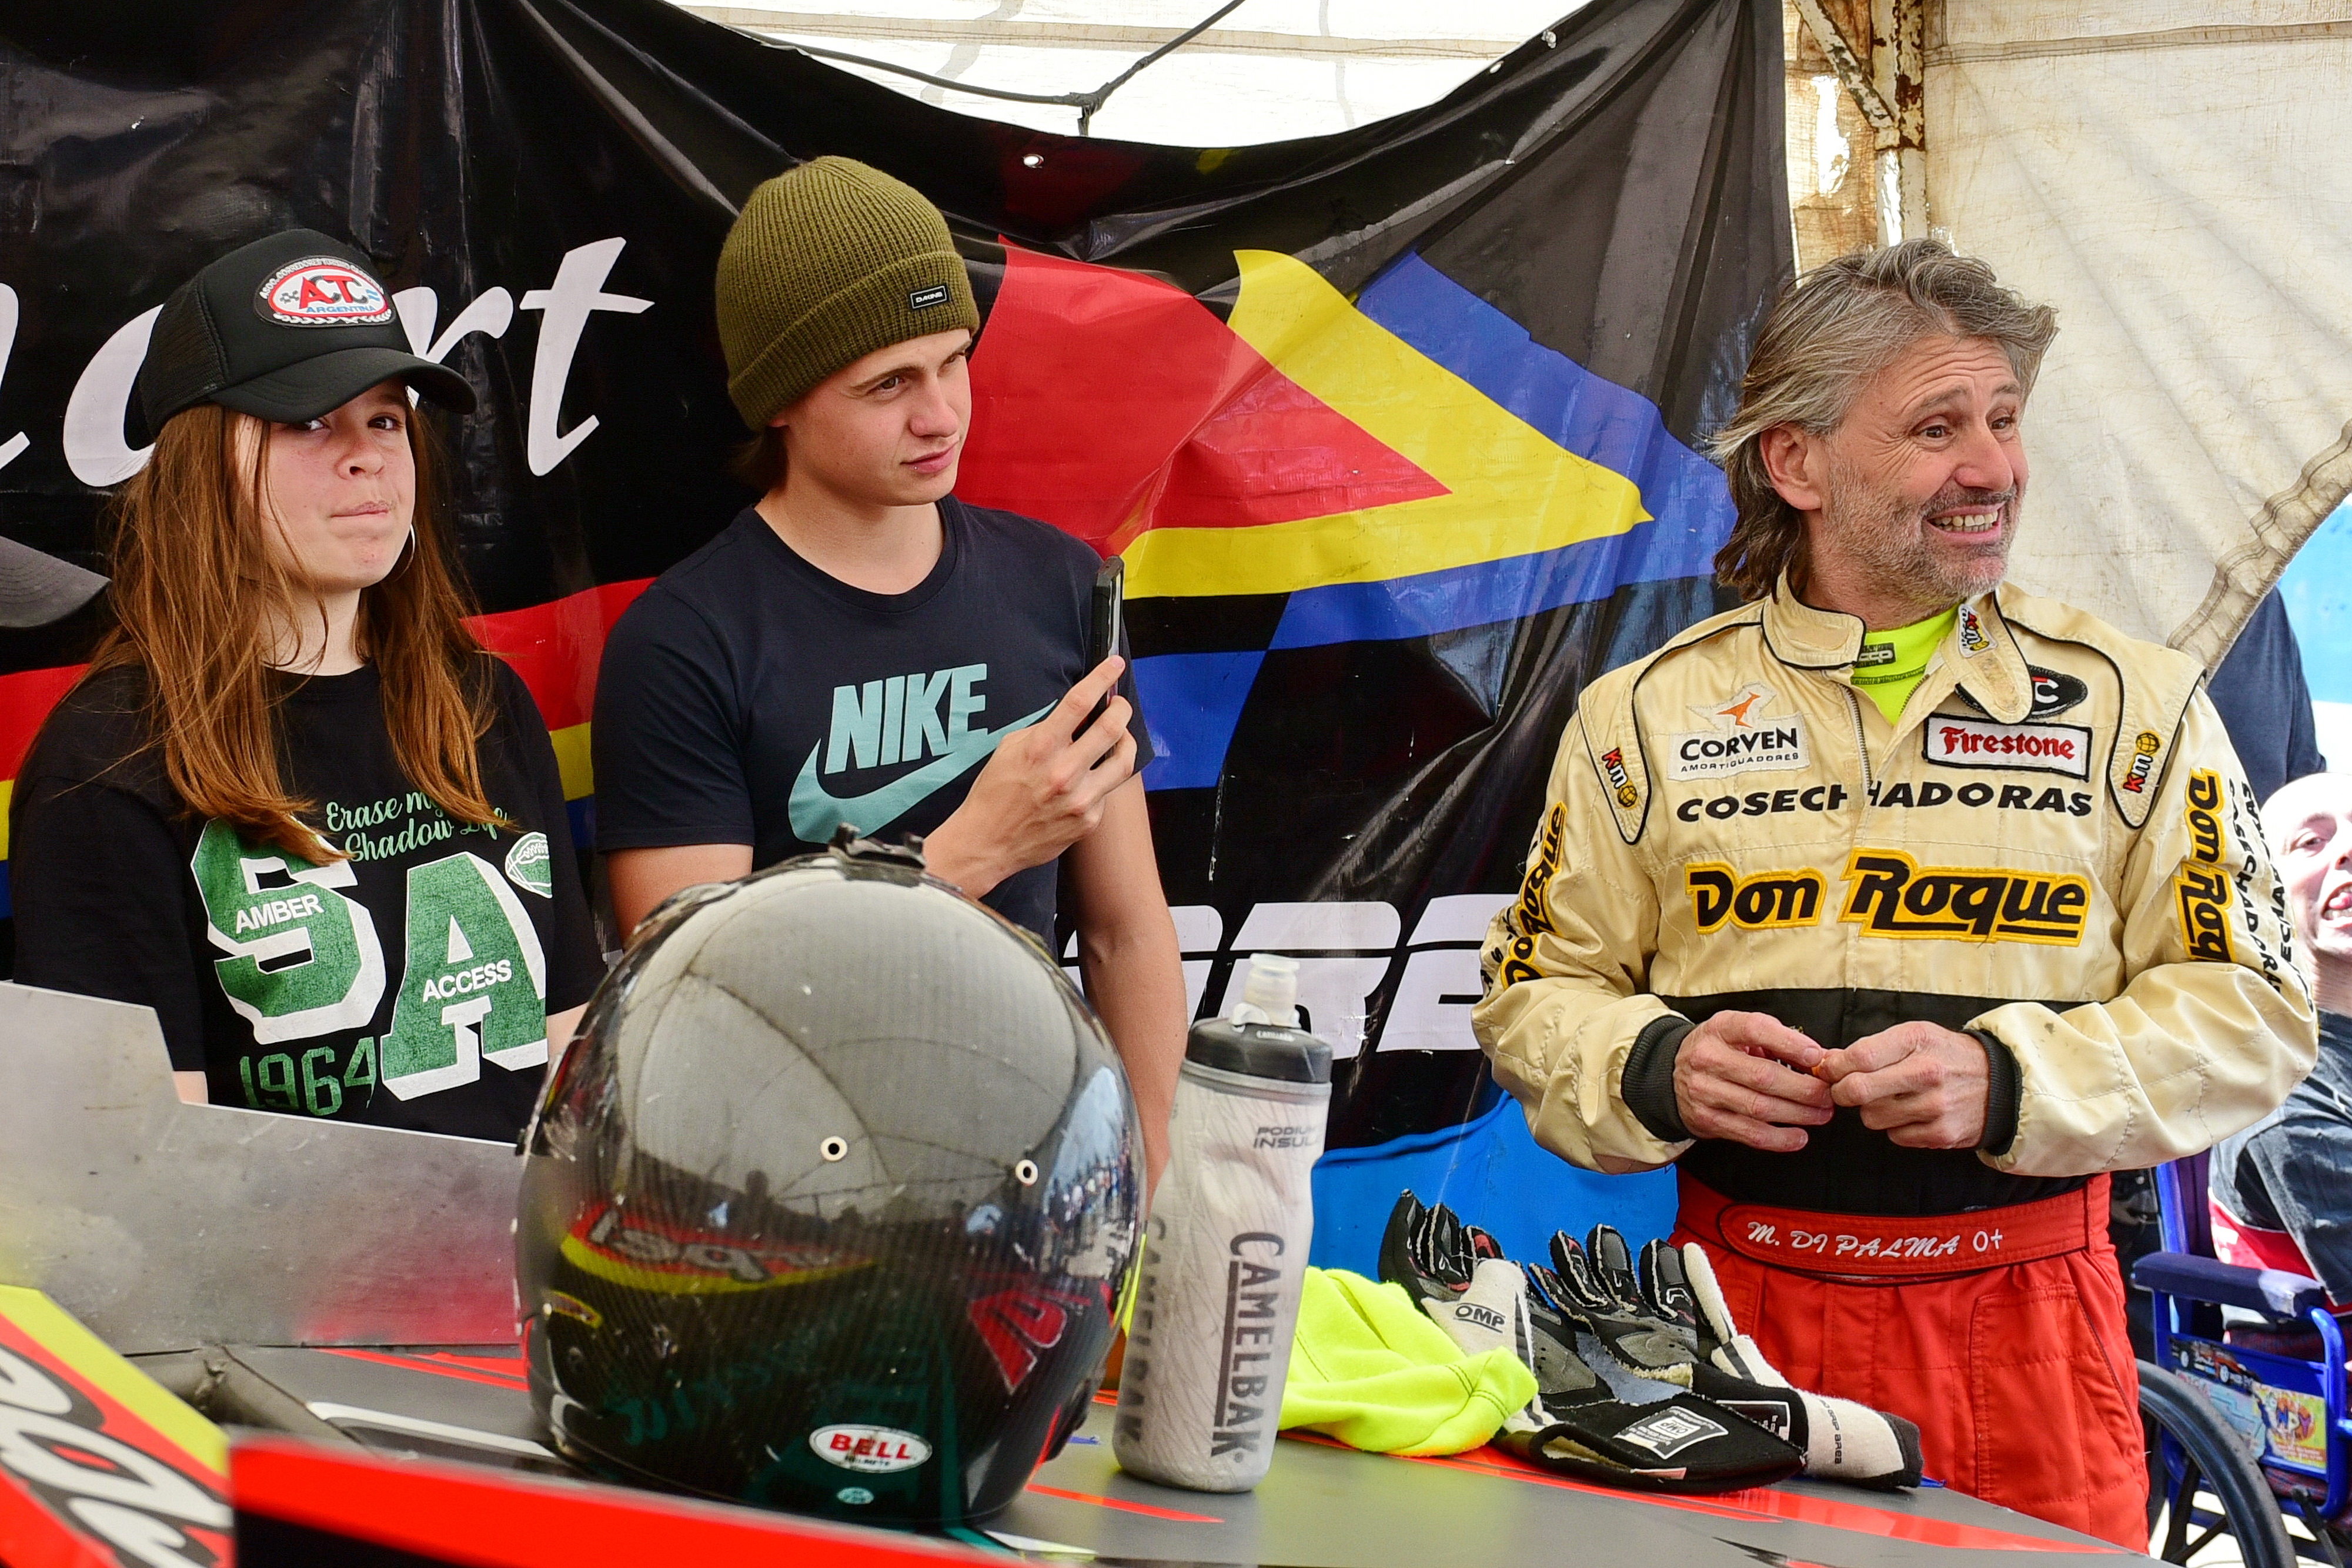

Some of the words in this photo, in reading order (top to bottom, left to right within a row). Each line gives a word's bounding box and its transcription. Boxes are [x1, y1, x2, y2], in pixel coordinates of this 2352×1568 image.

[306, 305, 376, 313] ARGENTINA
[825, 663, 988, 775] NIKE
[1680, 727, 1798, 761] CORVEN
[1681, 753, 1799, 773] AMORTIGUADORES
[1939, 726, 2076, 760] Firestone
[326, 798, 403, 832] Erase
[1676, 781, 2093, 823] COSECHADORAS
[2188, 775, 2220, 864] Don
[345, 818, 455, 862] Shadow
[236, 894, 324, 934] AMBER
[1689, 870, 1820, 928] Don
[1849, 857, 2083, 940] Roque
[422, 959, 513, 1003] ACCESS
[239, 1036, 377, 1116] 1964
[1748, 1221, 1780, 1247] M.
[1790, 1230, 1828, 1253] DI
[1835, 1235, 1961, 1258] PALMA
[1455, 1305, 1506, 1328] OMP
[1211, 1232, 1285, 1458] CAMELBAK
[830, 1433, 911, 1459] BELL
